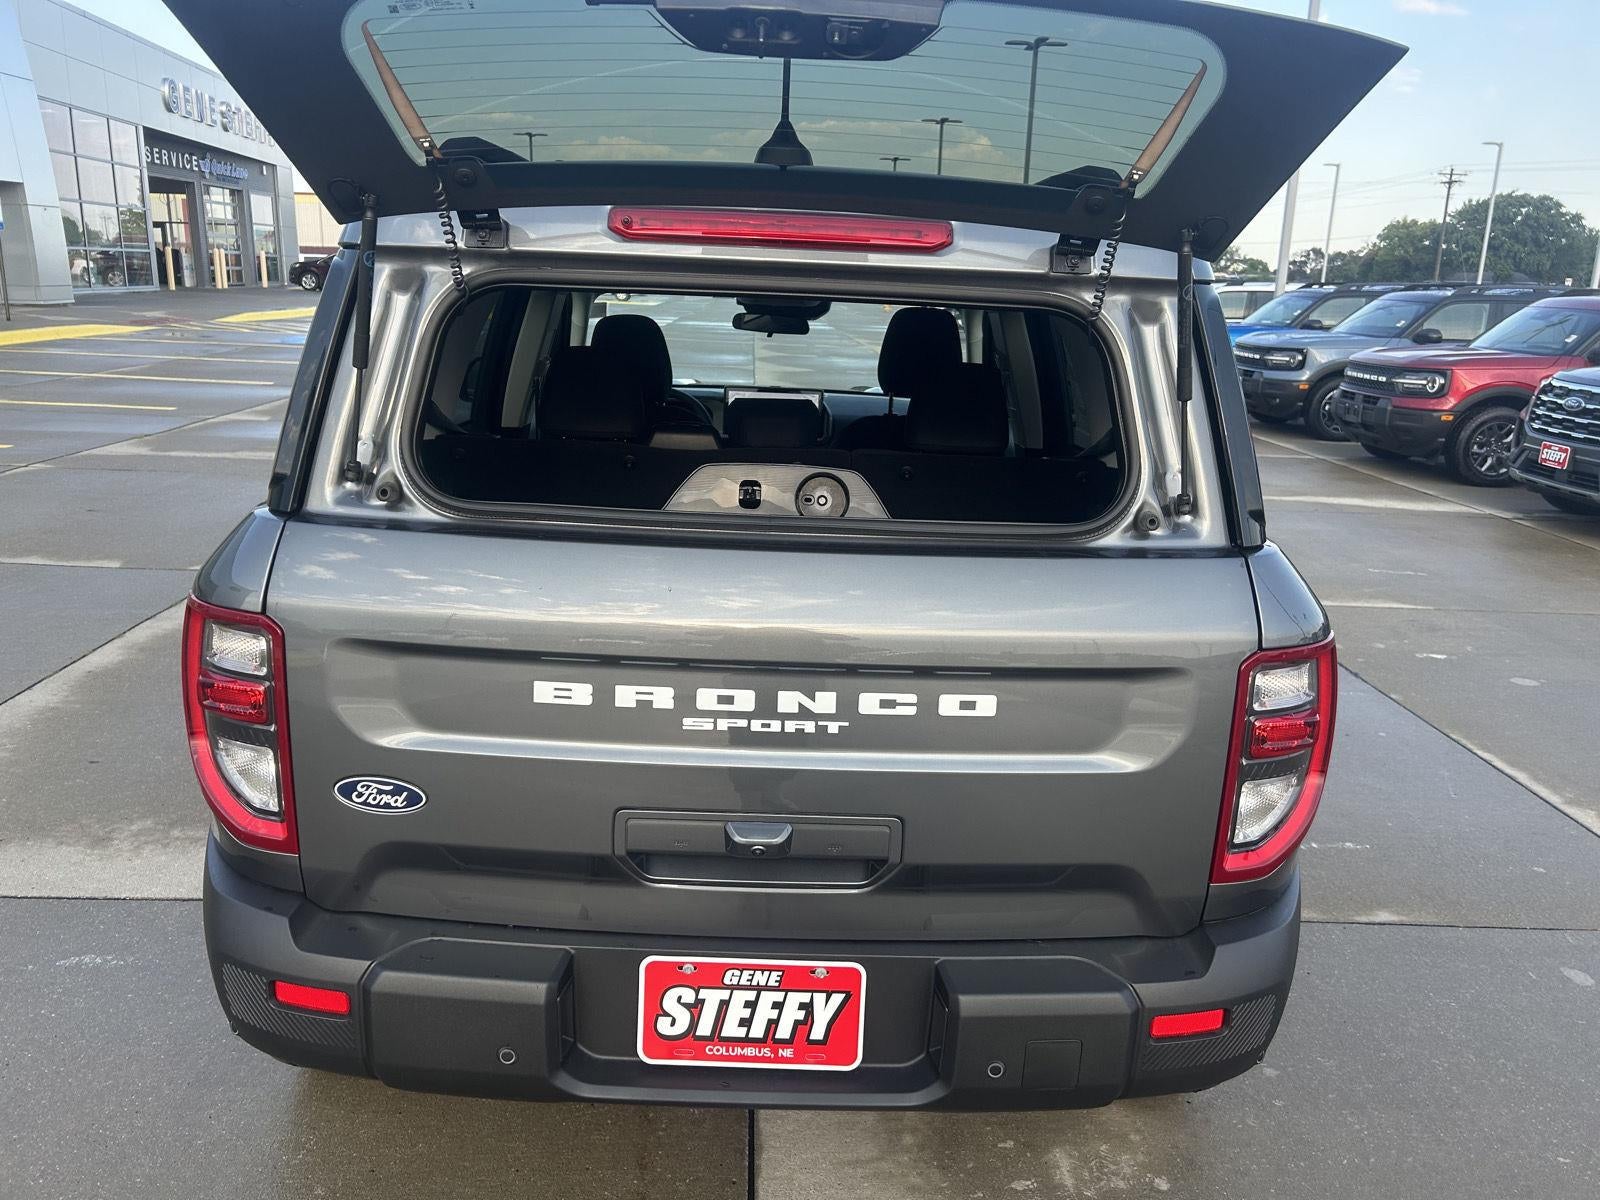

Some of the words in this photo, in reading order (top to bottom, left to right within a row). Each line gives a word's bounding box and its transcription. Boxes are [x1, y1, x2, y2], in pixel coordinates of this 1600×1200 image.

[161, 77, 217, 127] GENE
[144, 145, 199, 171] SERVICE
[1346, 370, 1387, 382] BRONCO
[1541, 448, 1567, 463] STEFFY
[533, 680, 998, 717] BRONCO
[682, 717, 849, 734] SPORT
[351, 781, 408, 808] Ford
[722, 968, 785, 987] GENE
[655, 986, 850, 1043] STEFFY
[705, 1045, 775, 1059] COLUMBUS,
[778, 1048, 794, 1058] NE
